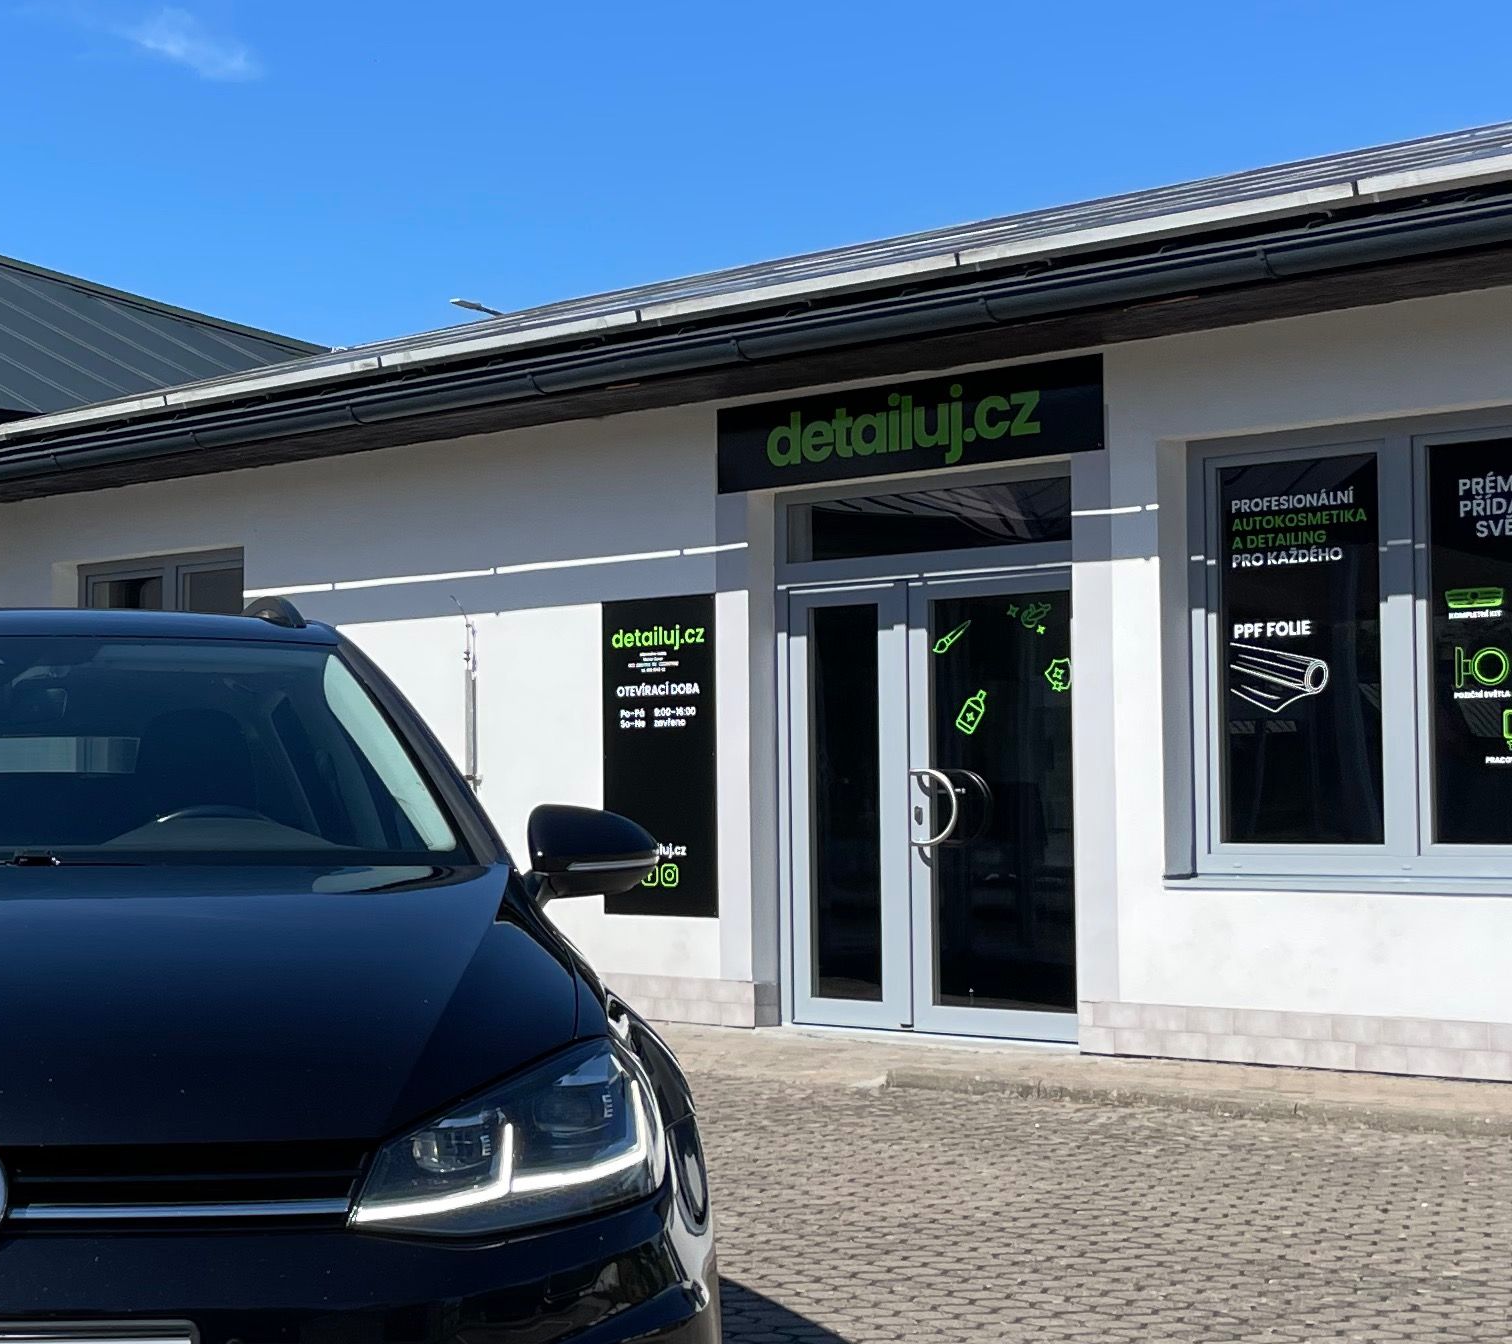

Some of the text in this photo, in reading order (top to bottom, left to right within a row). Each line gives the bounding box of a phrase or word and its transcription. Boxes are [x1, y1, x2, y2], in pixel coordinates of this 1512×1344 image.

[767, 384, 1041, 467] detailuj.cz
[1231, 486, 1354, 514] PROFESIONÁLNÍ
[1460, 494, 1512, 518] PŘÍD
[1232, 508, 1367, 532] AUTOKOSMETIKA
[1232, 530, 1327, 550] A DETAILING
[1232, 545, 1343, 568] PRO KAŽDÉHO
[612, 624, 705, 650] detailuj.cz
[1233, 619, 1312, 639] PPF FOLIE
[616, 681, 700, 697] OTEVÍRACÍ DOBA
